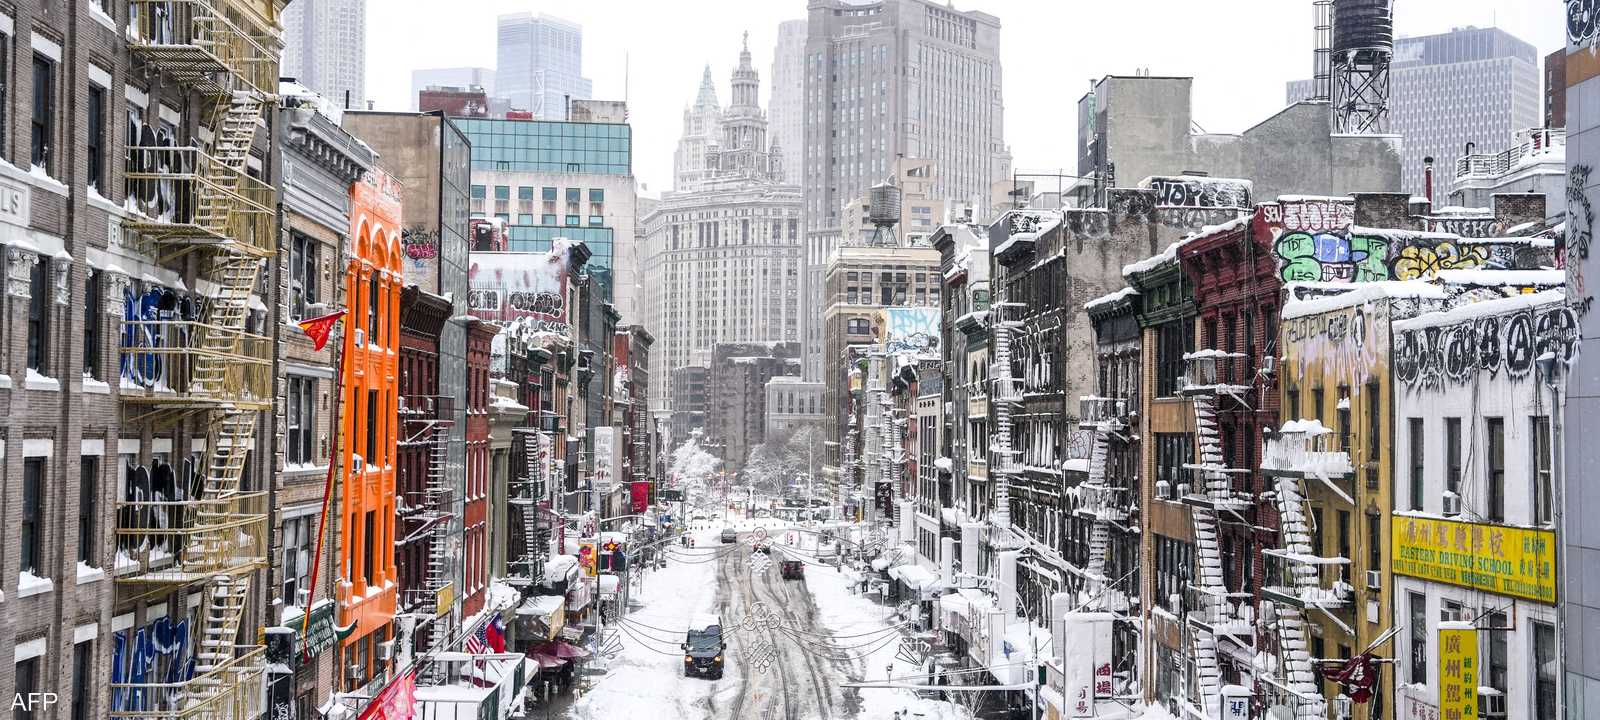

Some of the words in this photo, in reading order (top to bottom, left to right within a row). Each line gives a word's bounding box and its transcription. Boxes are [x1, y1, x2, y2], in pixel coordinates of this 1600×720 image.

[1400, 546, 1436, 564] EASTERN
[1440, 551, 1473, 569] DRIVING
[1478, 556, 1513, 576] SCHOOL
